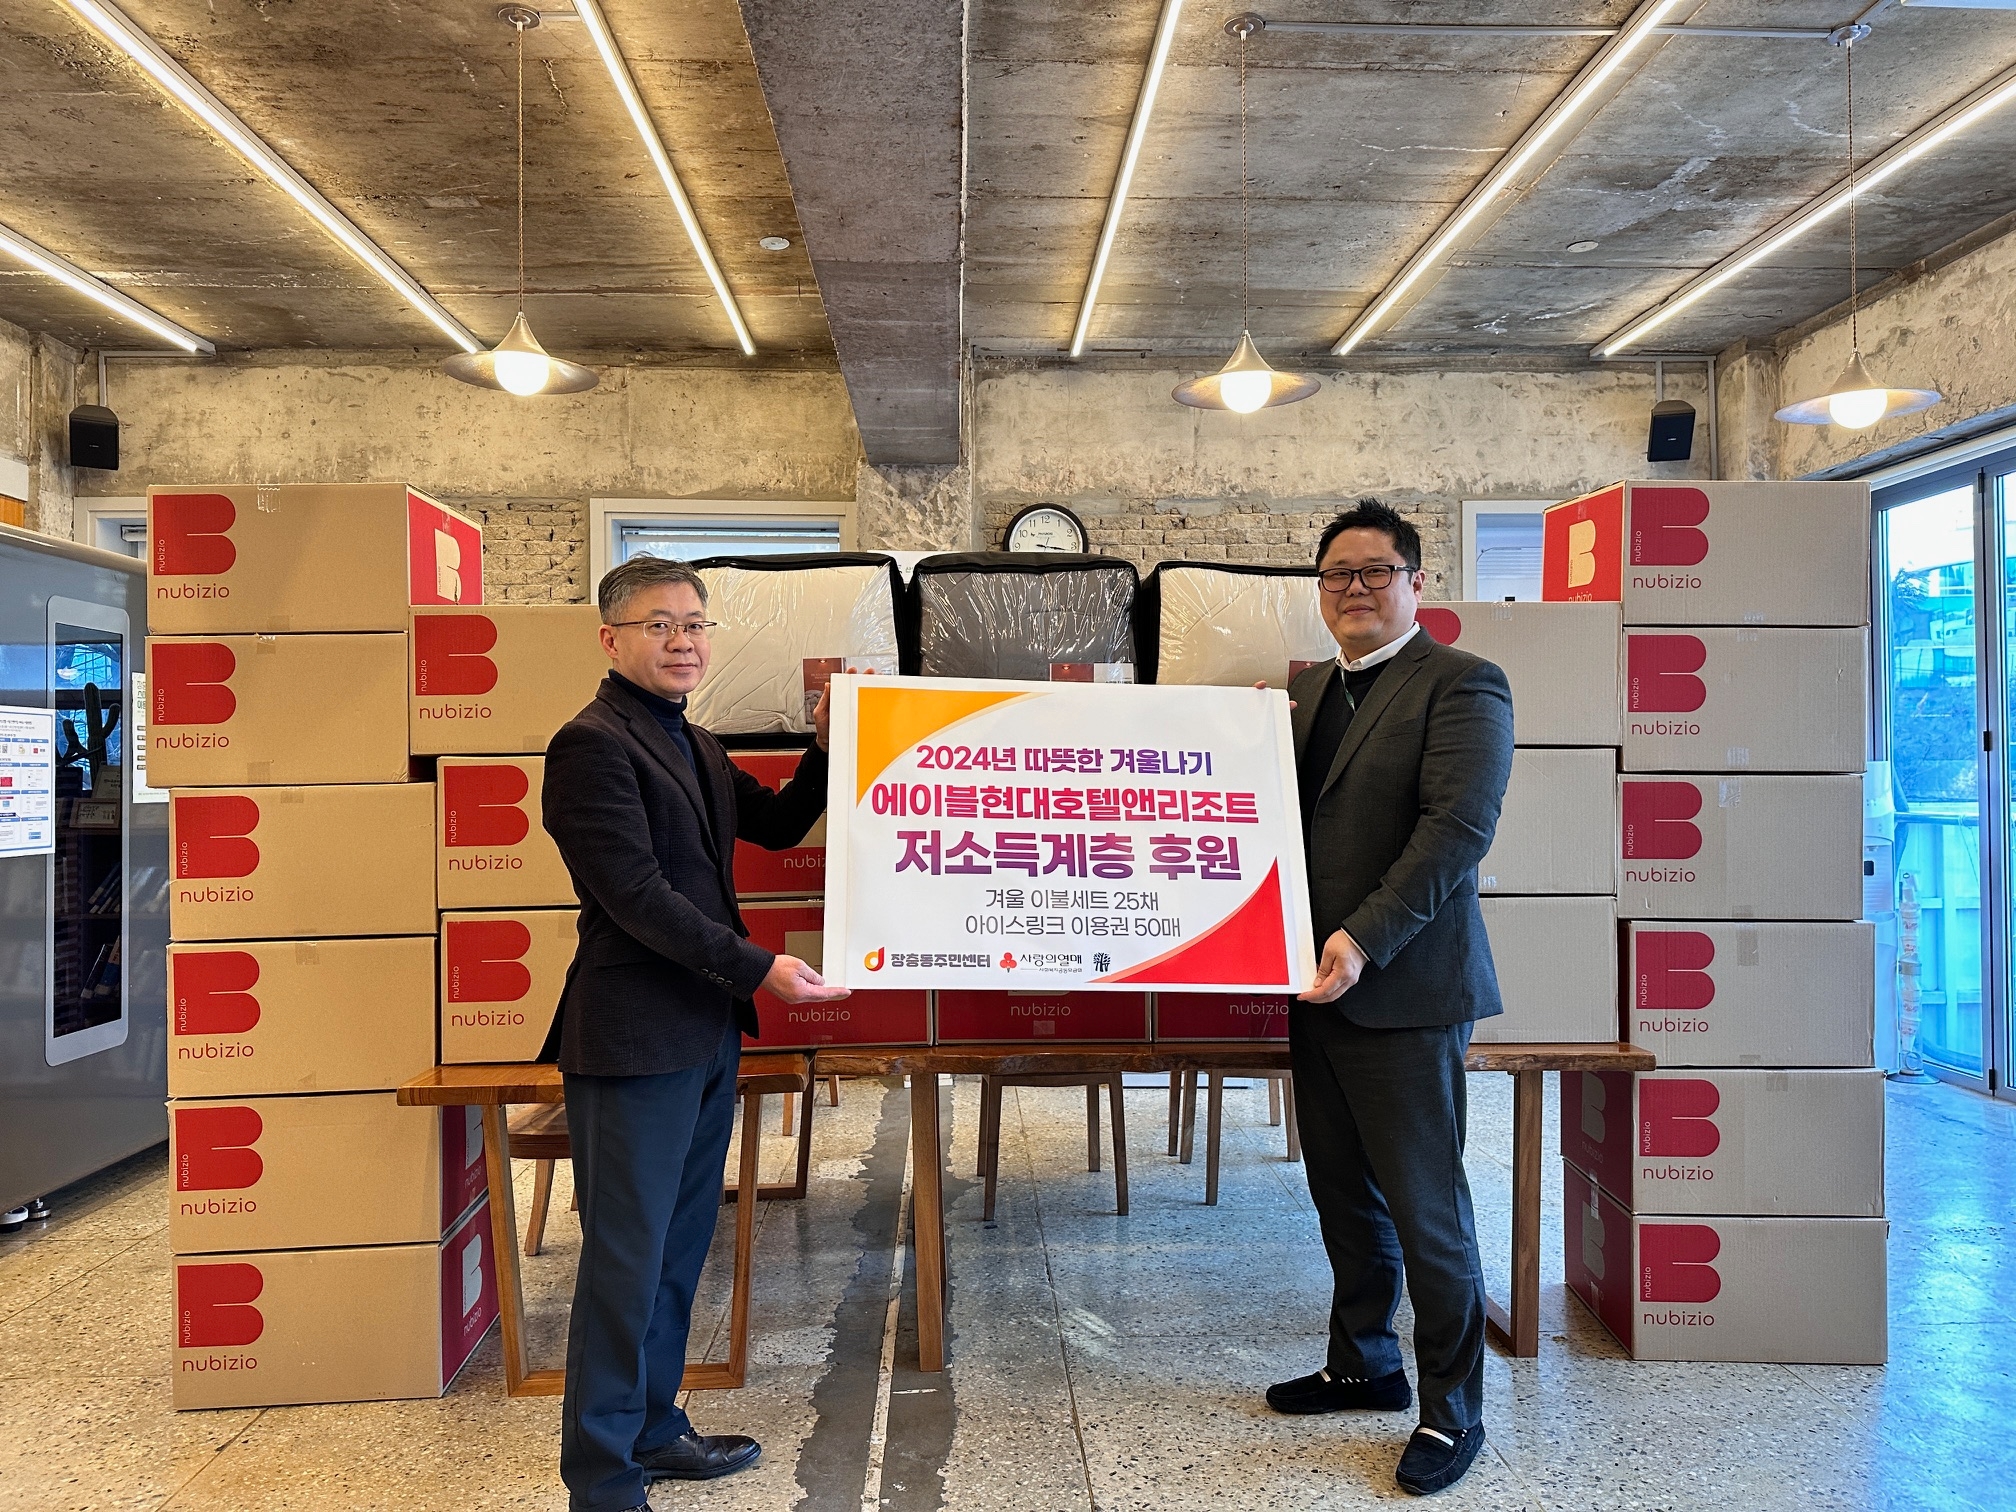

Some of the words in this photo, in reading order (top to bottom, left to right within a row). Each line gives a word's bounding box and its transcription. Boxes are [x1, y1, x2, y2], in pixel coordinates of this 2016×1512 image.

[1029, 519, 1036, 528] 11
[1041, 515, 1050, 524] 12
[1057, 518, 1060, 527] 1
[1019, 530, 1028, 538] 10
[1066, 528, 1072, 538] 2
[1014, 542, 1020, 551] 9
[1634, 530, 1642, 562] nubizio
[157, 539, 166, 572] nubizio
[1633, 574, 1702, 589] nubizio
[157, 583, 230, 599] nubizio
[419, 659, 428, 692] nubizio
[1632, 677, 1640, 709] nubizio
[156, 688, 165, 722] nubizio
[419, 703, 492, 719] nubizio
[1631, 721, 1700, 736] nubizio
[156, 733, 230, 749] nubizio
[915, 744, 1017, 773] 2024년
[1024, 747, 1104, 774] 따뜻한
[1109, 748, 1213, 777] 겨울나기
[871, 782, 1259, 824] 에이블현대호텔앤리조트
[449, 810, 457, 843] nubizio
[180, 842, 189, 875] nubizio
[448, 854, 523, 871] nubizio
[895, 829, 1135, 880] 저소득계층
[1149, 833, 1242, 881] 후원
[1626, 867, 1696, 883] nubizio
[180, 886, 254, 903] nubizio
[985, 888, 1025, 910] 겨울
[1031, 889, 1109, 911] 이불세트
[1113, 891, 1159, 912] 25채
[965, 914, 1066, 937] 아이스링크
[1071, 916, 1130, 938] 이용권
[1134, 917, 1181, 938] 50매
[890, 952, 991, 968] 장충동주민센터
[452, 966, 460, 999] nubizio
[1640, 974, 1648, 1006] nubizio
[179, 998, 188, 1032] nubizio
[788, 1008, 851, 1023] nubizio
[1010, 1003, 1071, 1016] nubizio
[1229, 1001, 1289, 1015] nubizio
[451, 1010, 525, 1027] nubizio
[1639, 1017, 1709, 1033] nubizio
[178, 1042, 254, 1060] nubizio
[1643, 1121, 1652, 1154] nubizio
[181, 1154, 190, 1188] nubizio
[1643, 1165, 1714, 1181] nubizio
[181, 1198, 257, 1215] nubizio
[1644, 1266, 1652, 1298] nubizio
[183, 1310, 191, 1344] nubizio
[1643, 1311, 1715, 1326] nubizio
[182, 1355, 258, 1372] nubizio
